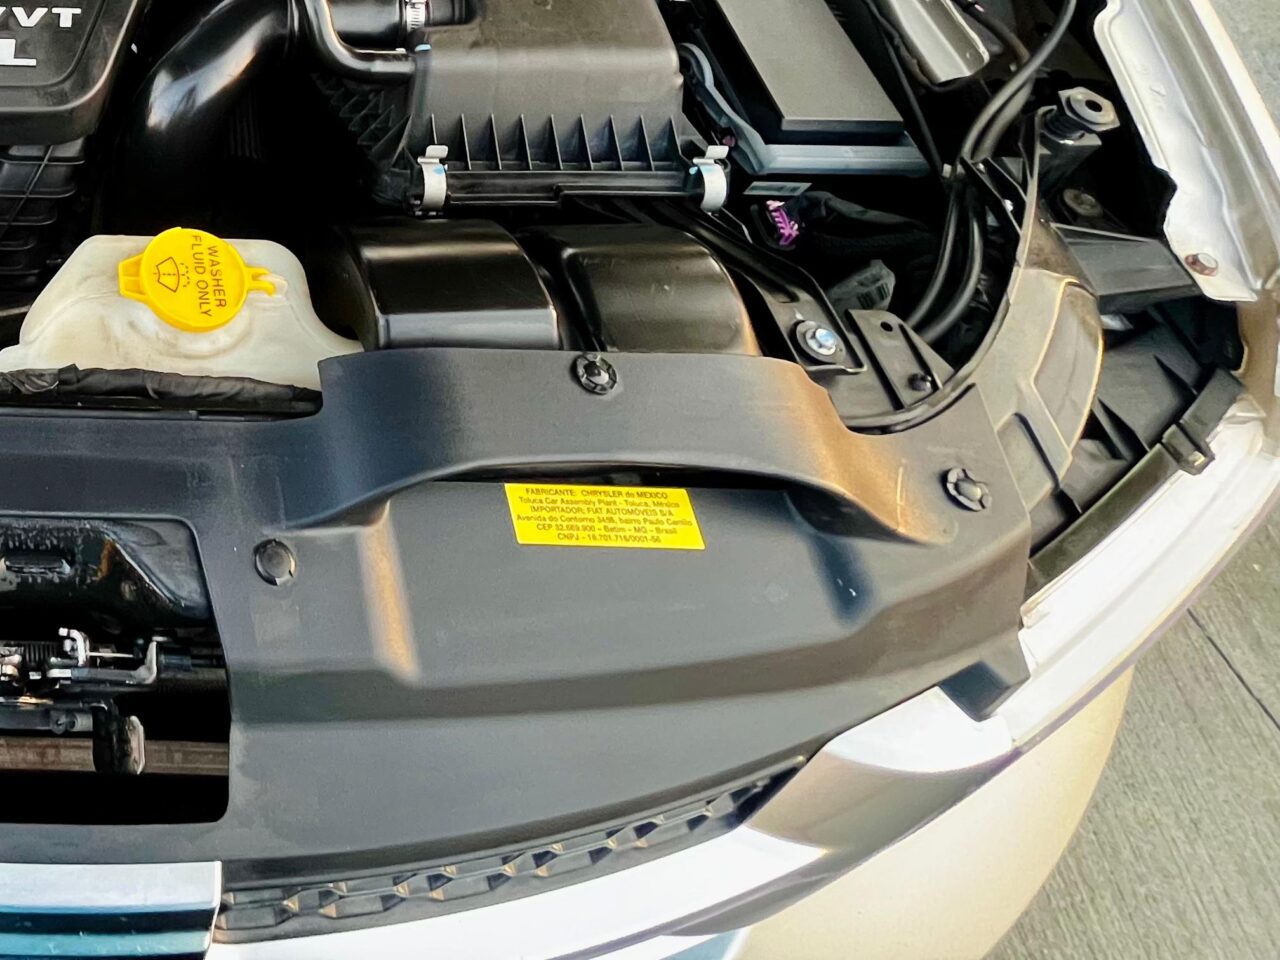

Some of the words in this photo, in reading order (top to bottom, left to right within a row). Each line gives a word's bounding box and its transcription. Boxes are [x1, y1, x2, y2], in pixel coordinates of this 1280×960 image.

[191, 235, 207, 275] FLUID
[207, 245, 227, 308] WASHER
[196, 280, 213, 318] ONLY
[581, 489, 623, 498] CHRYSLER
[519, 495, 544, 504] Toluca
[560, 498, 596, 507] Assembly
[597, 498, 617, 506] Plant
[587, 507, 603, 515] FIAT
[516, 514, 547, 522] Avenida
[559, 515, 596, 523] Contorno
[643, 517, 664, 526] Paulo
[536, 523, 553, 531] CEP
[603, 525, 626, 533] Betim
[633, 526, 648, 534] MG
[655, 526, 678, 534] Brasil
[557, 532, 580, 541] CNPJ
